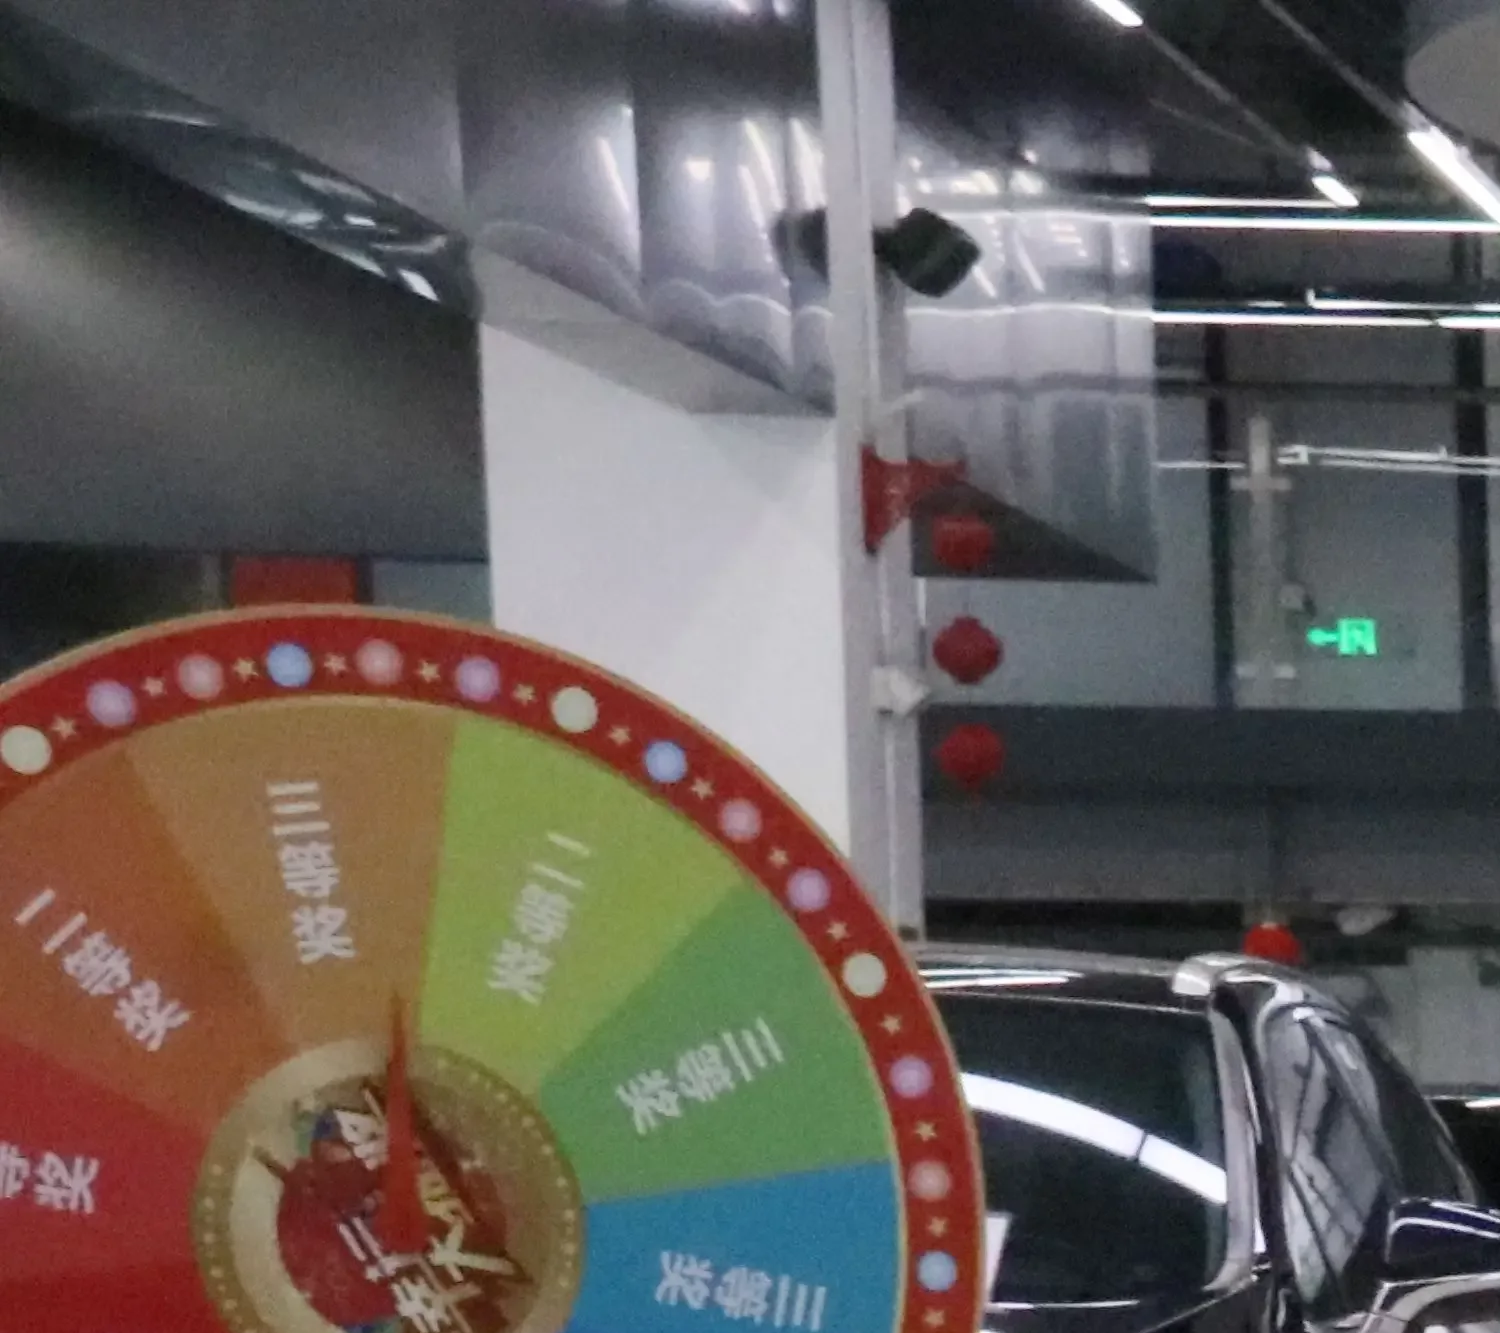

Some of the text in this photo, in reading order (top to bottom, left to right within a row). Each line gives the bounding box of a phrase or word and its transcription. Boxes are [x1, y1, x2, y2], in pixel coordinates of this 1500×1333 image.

[266, 781, 357, 964] 三等奖
[487, 832, 592, 1007] 二等奖
[15, 888, 191, 1051] 二等奖
[615, 1016, 784, 1136] 三等奖
[655, 1251, 827, 1332] 三等奖
